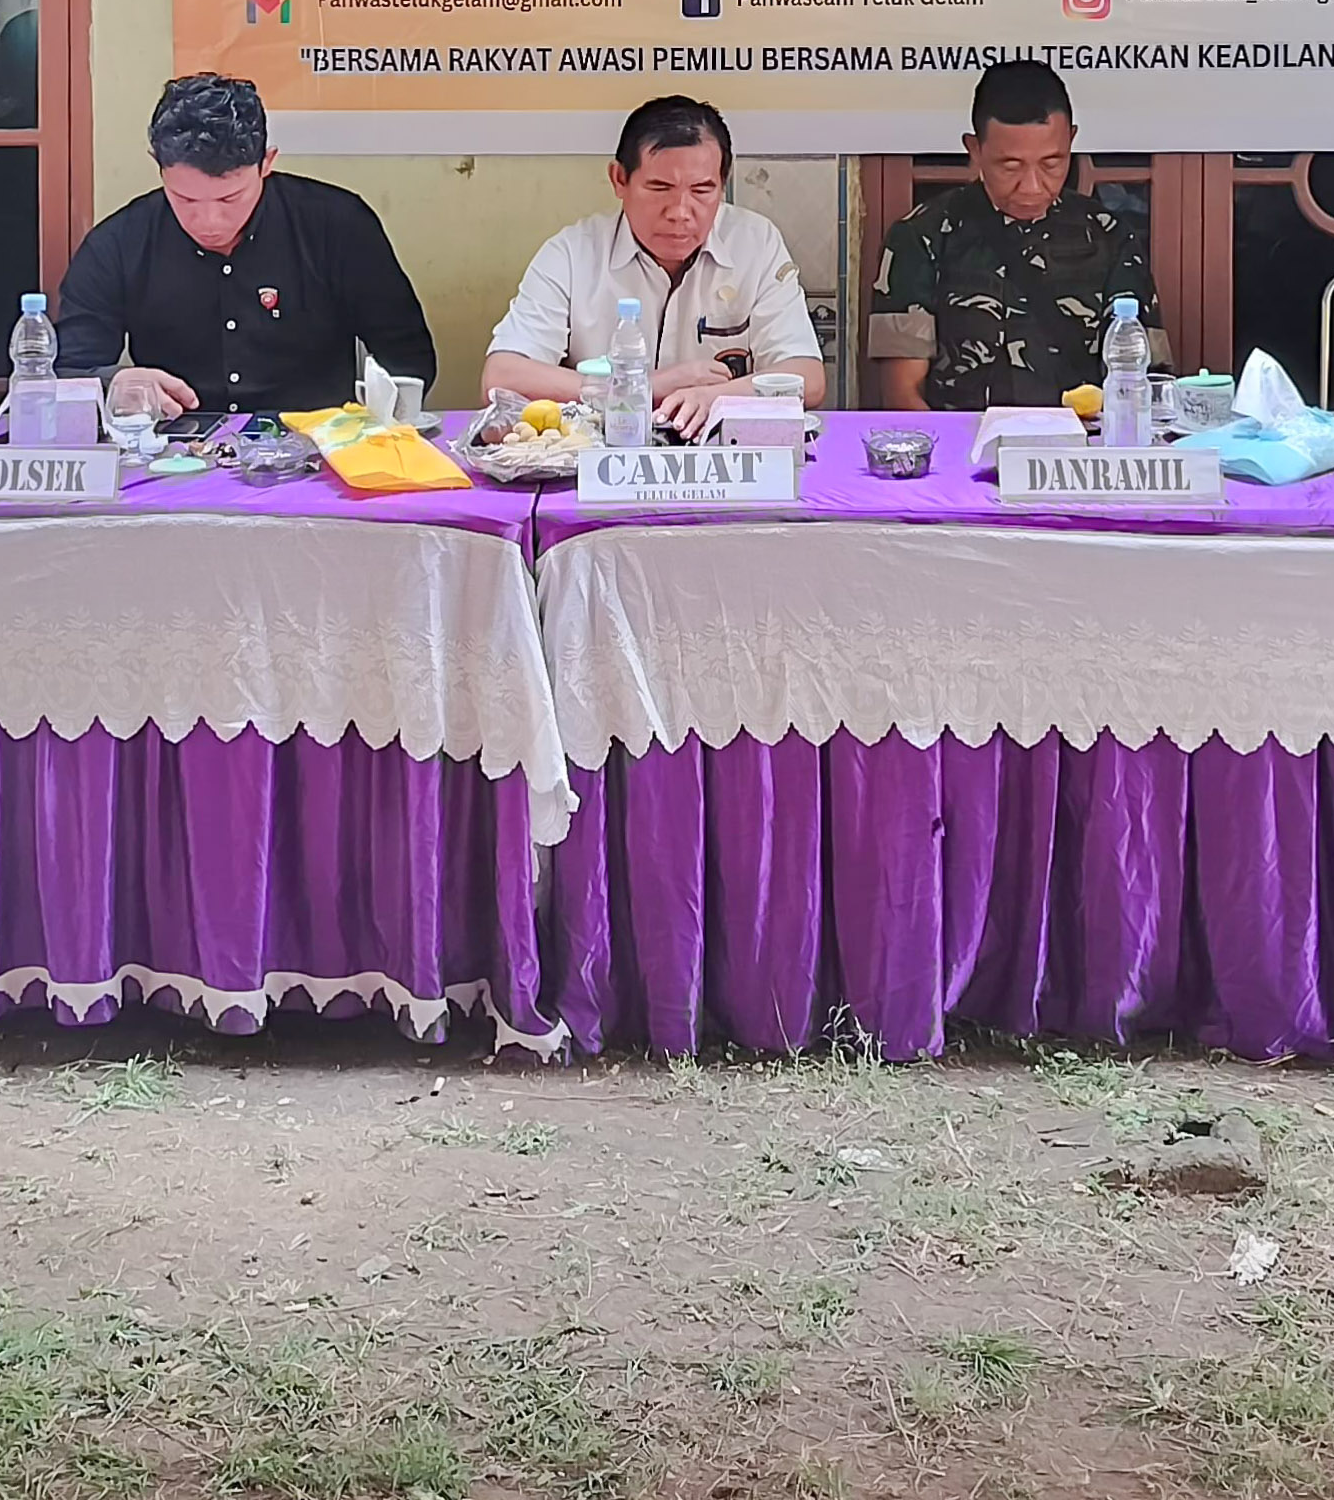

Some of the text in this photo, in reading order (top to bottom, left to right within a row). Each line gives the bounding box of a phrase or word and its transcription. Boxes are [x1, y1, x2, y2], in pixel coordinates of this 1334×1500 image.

[300, 46, 442, 73] "BERSAMA
[448, 47, 553, 73] RAKYAT
[558, 47, 645, 73] AWASI
[652, 46, 754, 72] PEMILU
[762, 46, 893, 72] BERSAMA
[1041, 44, 1190, 70] TEGAKKAN
[596, 451, 763, 487] CAMAT
[1027, 457, 1192, 492] DANRAMIL
